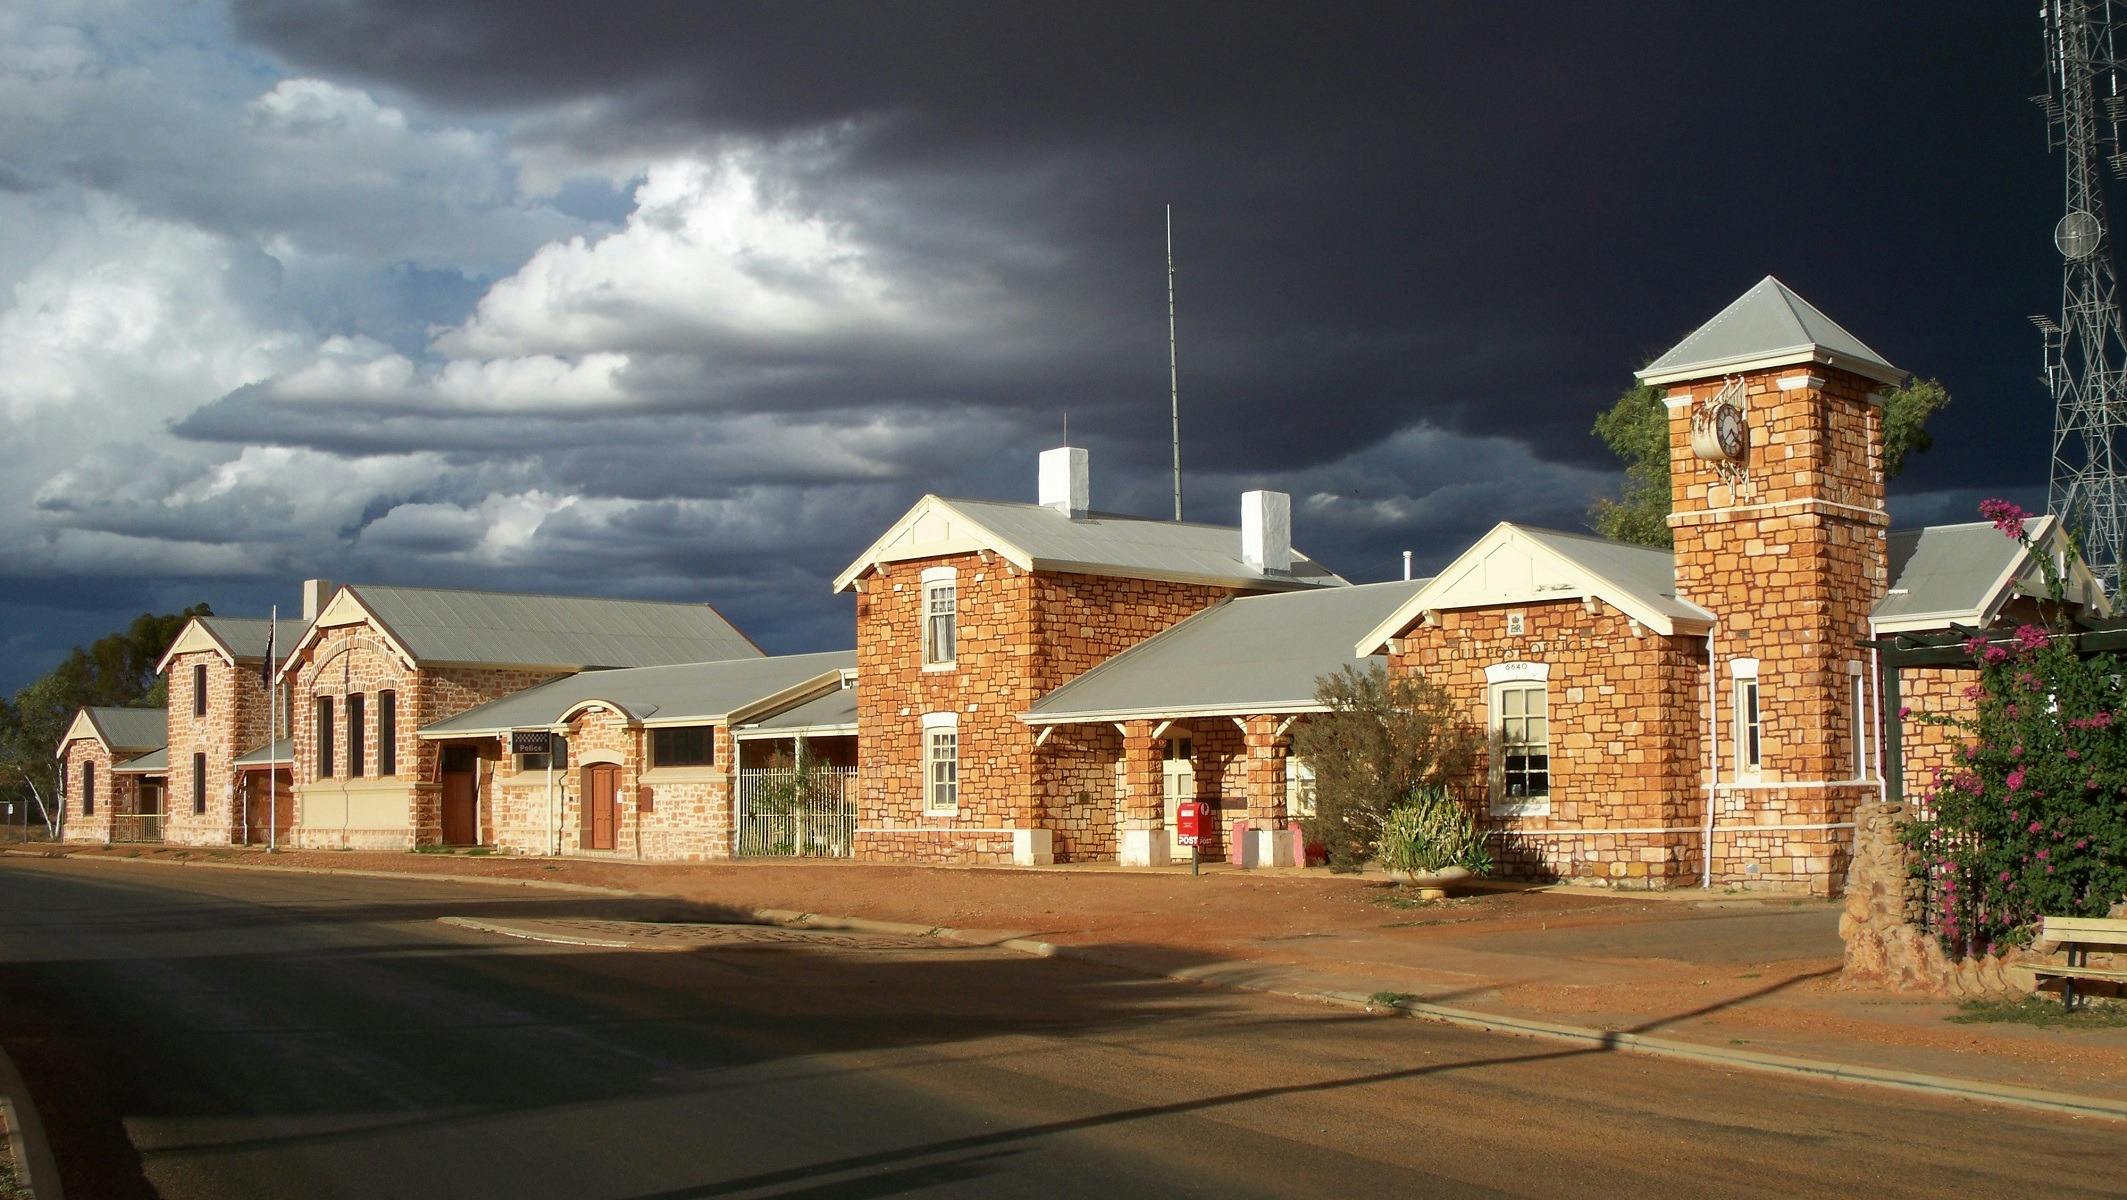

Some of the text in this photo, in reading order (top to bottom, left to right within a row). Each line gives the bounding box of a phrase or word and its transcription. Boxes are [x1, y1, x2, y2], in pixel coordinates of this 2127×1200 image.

[1505, 663, 1527, 671] 6640
[520, 744, 542, 752] Police
[1178, 836, 1198, 844] POST
